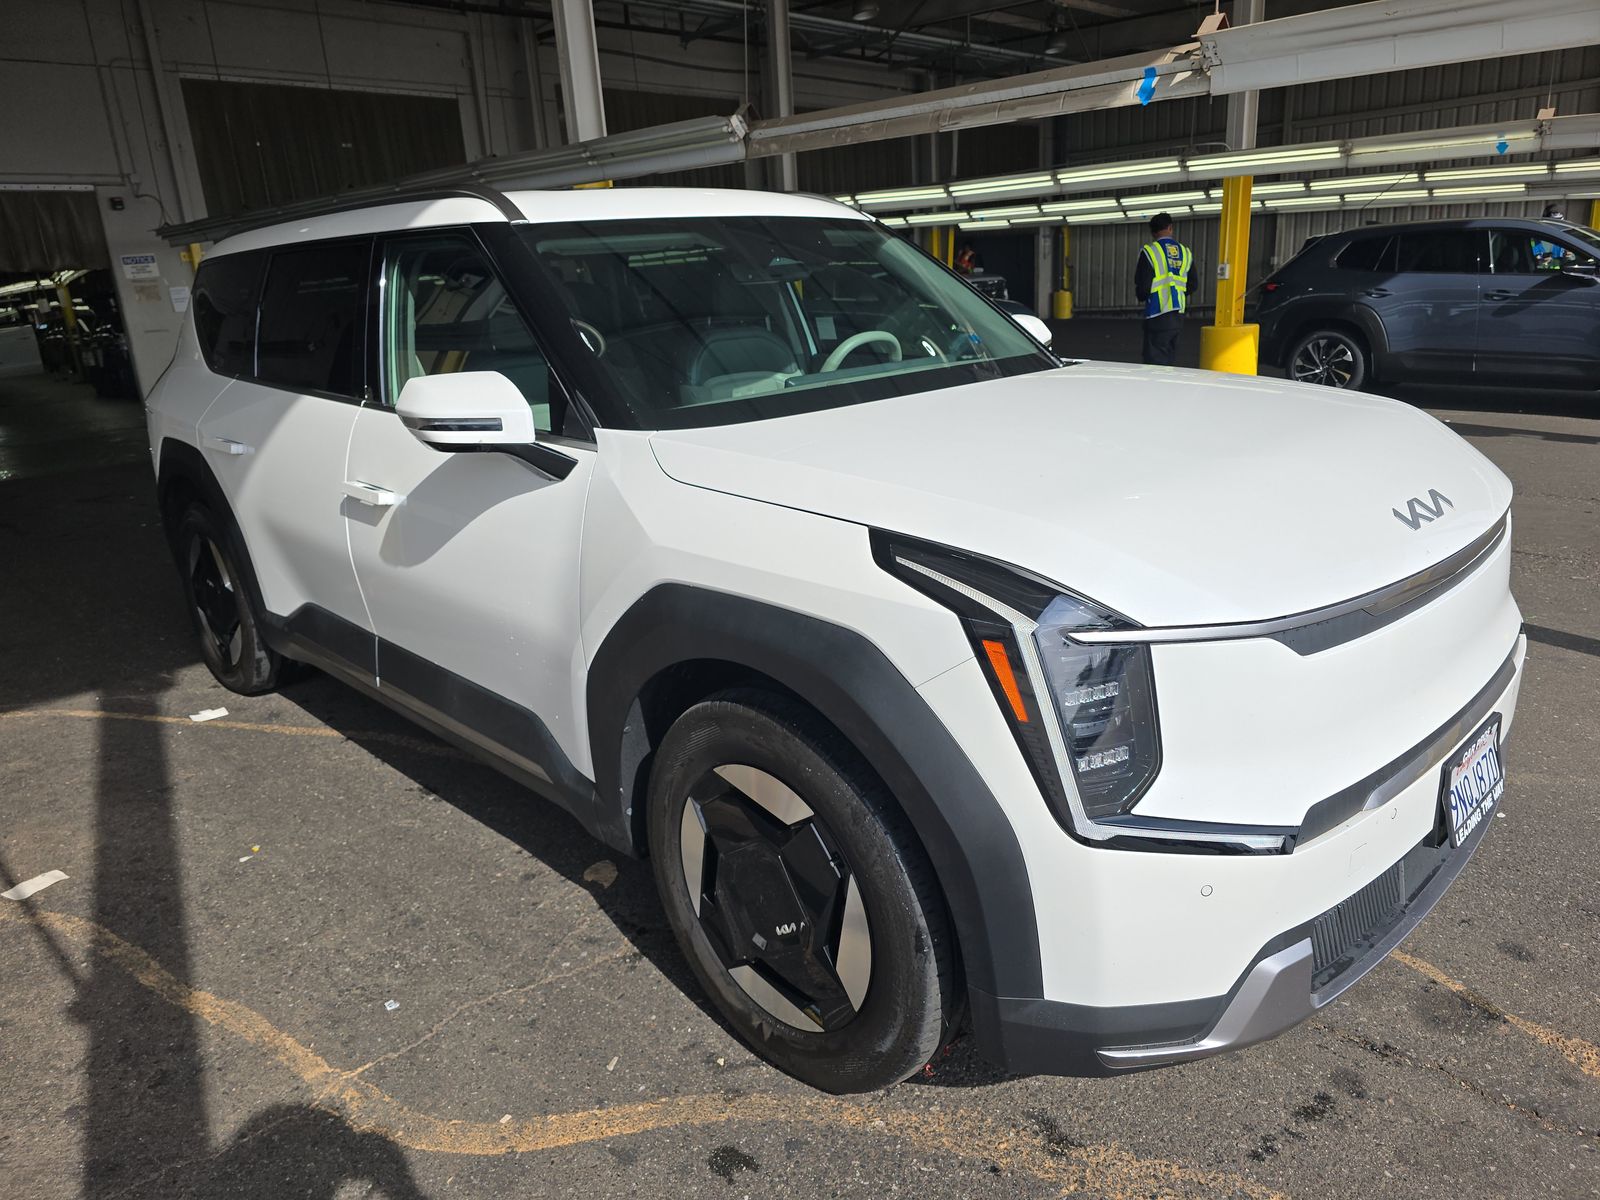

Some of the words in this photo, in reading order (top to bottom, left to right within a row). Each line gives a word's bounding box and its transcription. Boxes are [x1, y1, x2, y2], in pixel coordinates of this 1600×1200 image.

[123, 256, 154, 265] NOTICE
[1392, 488, 1454, 531] KIA
[1450, 748, 1500, 832] 9NQJ870
[1455, 809, 1482, 847] LEADING
[1481, 793, 1494, 815] THE
[775, 922, 797, 936] KIA
